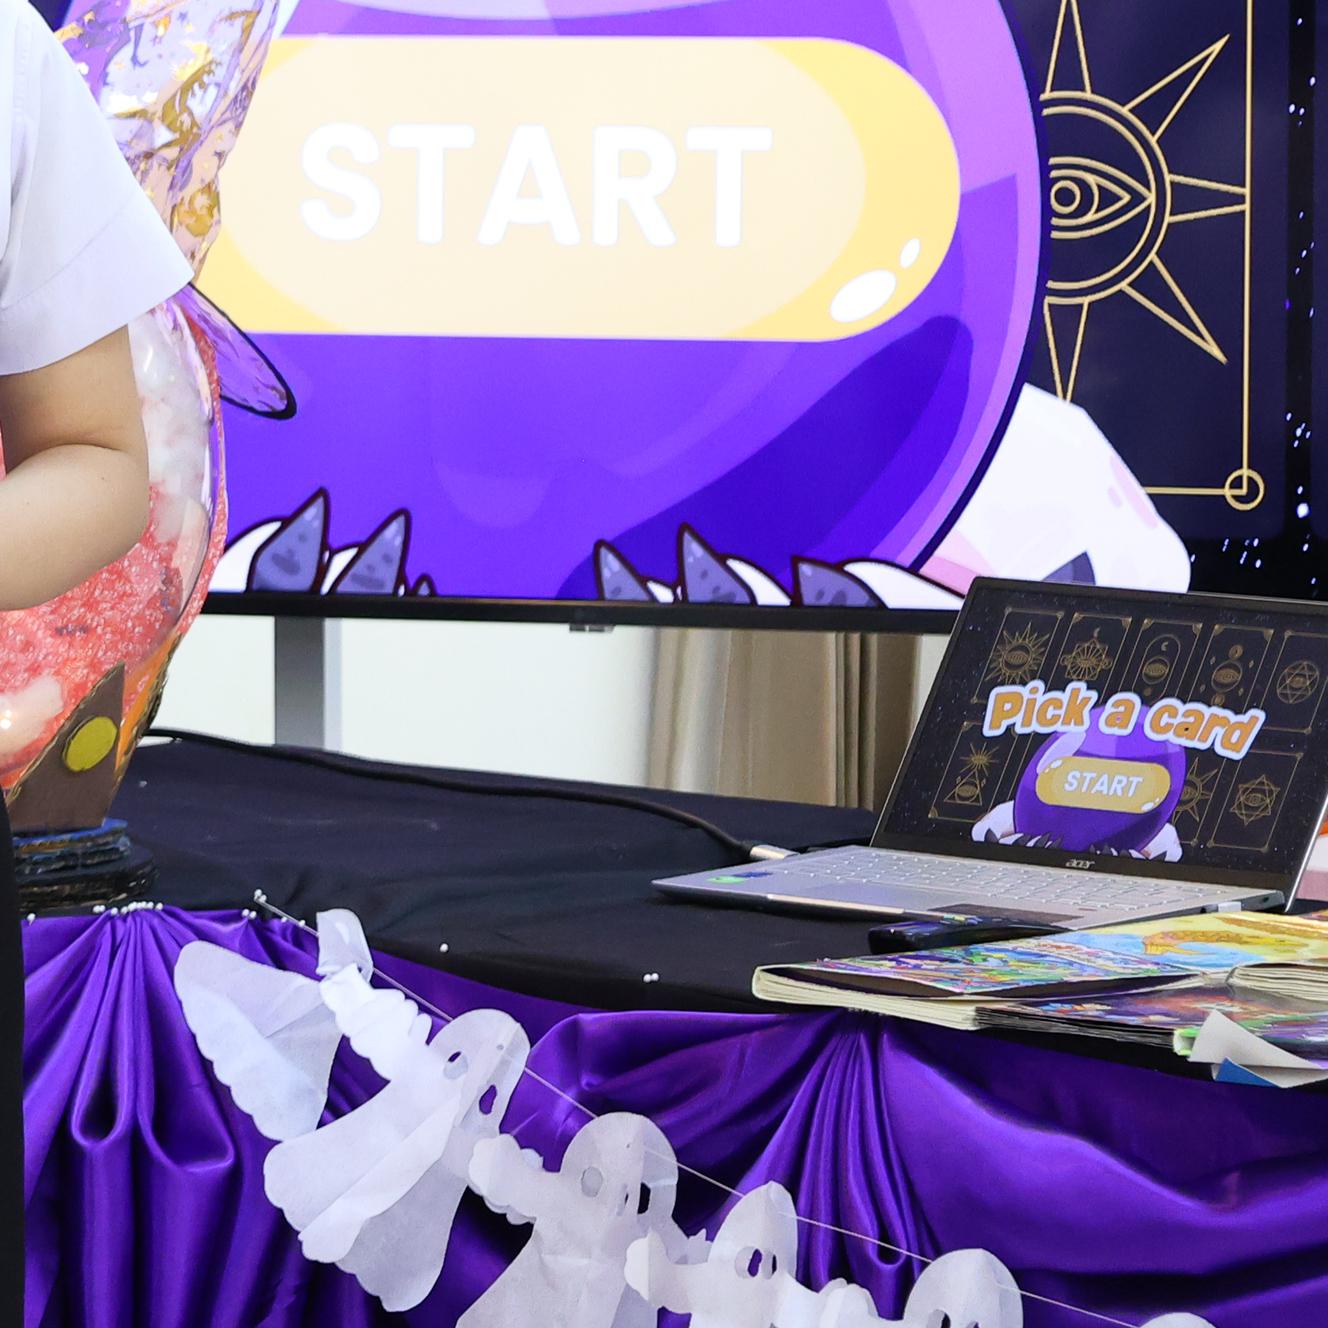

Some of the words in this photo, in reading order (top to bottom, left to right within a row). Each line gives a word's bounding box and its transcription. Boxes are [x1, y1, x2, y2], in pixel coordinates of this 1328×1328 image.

[298, 120, 774, 247] START
[988, 686, 1093, 730] Pick
[1104, 698, 1136, 730] a
[1148, 703, 1260, 754] card
[1063, 770, 1143, 798] START
[1065, 858, 1096, 870] acer
